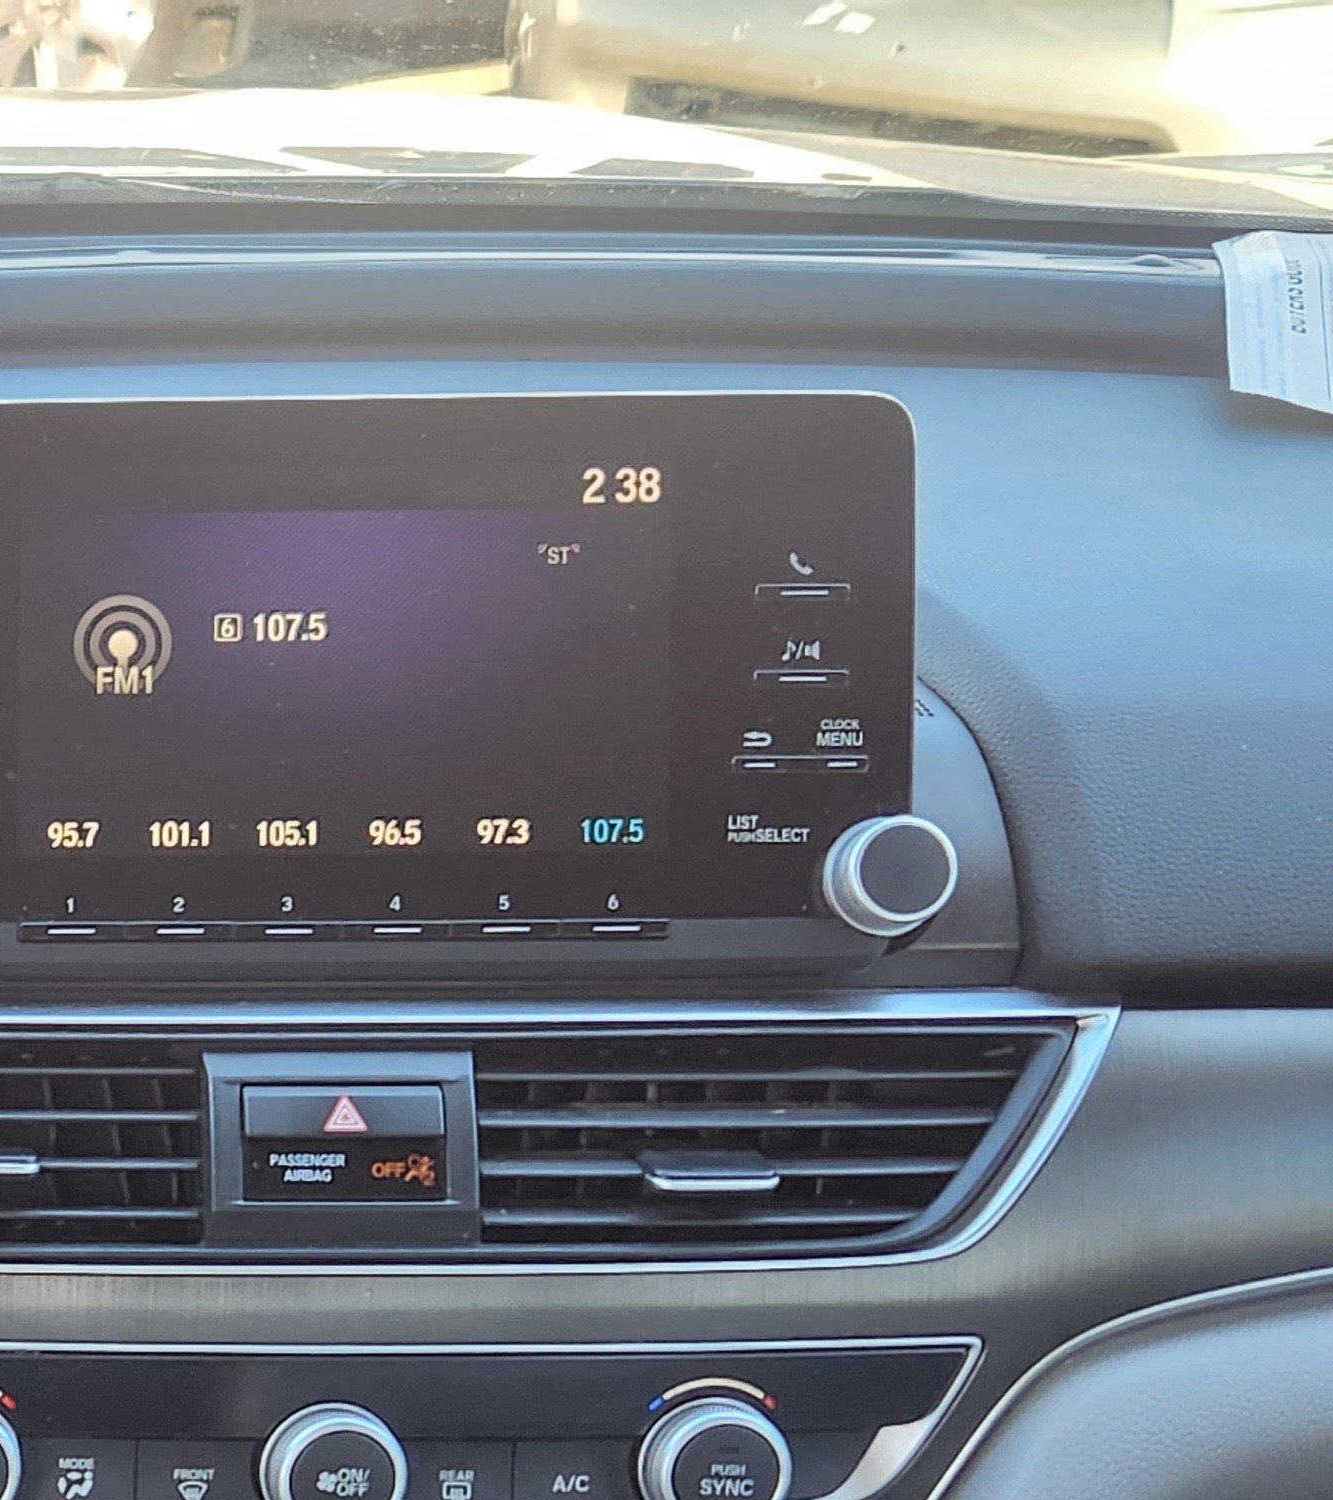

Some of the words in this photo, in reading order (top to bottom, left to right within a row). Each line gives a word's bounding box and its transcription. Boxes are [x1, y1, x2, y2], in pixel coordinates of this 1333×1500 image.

[220, 617, 235, 637] 6
[253, 613, 328, 642] 107.5
[96, 665, 154, 695] FM1
[820, 719, 861, 730] CLOCK
[816, 731, 864, 747] MENU
[727, 815, 760, 830] LIST
[47, 821, 100, 848] 95.7
[149, 821, 211, 847] 101.1
[255, 820, 318, 847] 105.1
[369, 818, 422, 846] 96.5
[476, 818, 530, 846] 97.3
[580, 817, 644, 844] 107.5
[65, 896, 77, 914] 1
[171, 896, 186, 914] 2
[280, 895, 294, 913] 3
[388, 895, 401, 911] 4
[497, 894, 510, 911] 5
[606, 894, 619, 911] 6
[269, 1153, 346, 1168] PASSENGER
[283, 1169, 333, 1183] AIRBAG
[371, 1162, 406, 1179] OFF
[58, 1457, 95, 1470] MODE
[711, 1463, 746, 1476] PUSH
[173, 1468, 215, 1482] FRONT
[337, 1468, 370, 1482] ON/
[439, 1470, 474, 1482] REAR
[337, 1482, 370, 1498] OFF
[552, 1475, 590, 1493] A/C
[699, 1479, 754, 1497] SYNC
